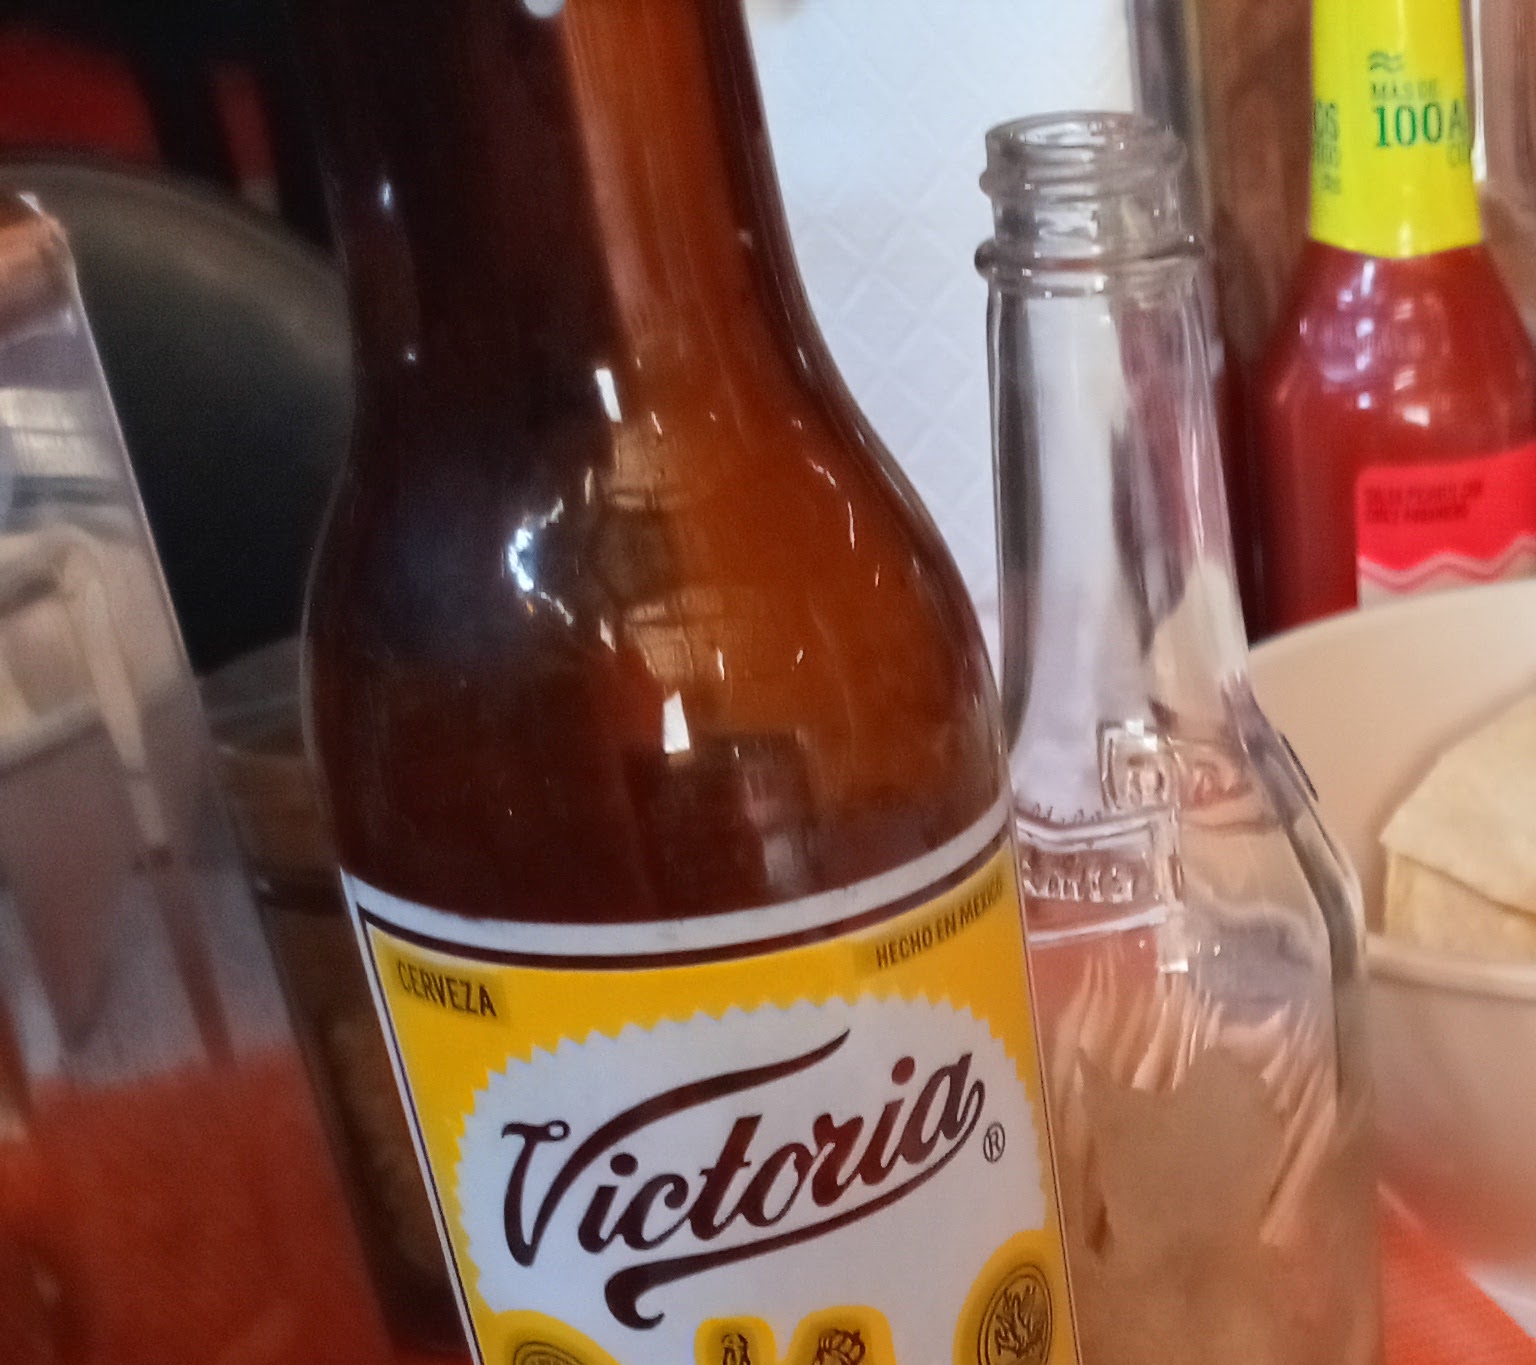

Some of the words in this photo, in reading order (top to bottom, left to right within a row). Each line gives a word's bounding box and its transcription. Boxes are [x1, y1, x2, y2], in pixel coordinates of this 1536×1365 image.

[1375, 102, 1442, 147] 100
[876, 926, 933, 969] HECHO
[935, 911, 958, 942] EN
[396, 960, 498, 1018] CERVEZA
[501, 1029, 985, 1330] Victoria
